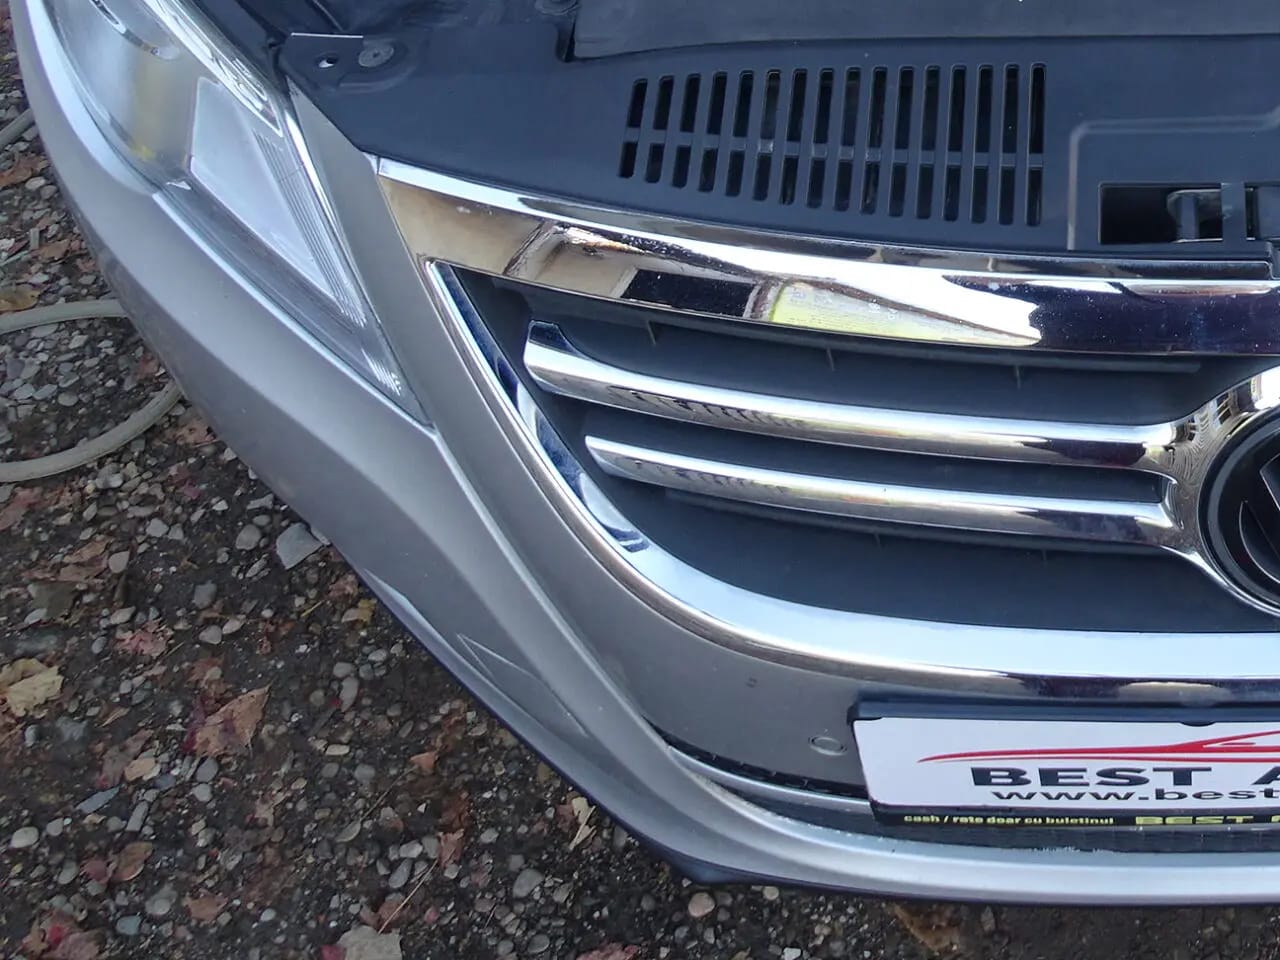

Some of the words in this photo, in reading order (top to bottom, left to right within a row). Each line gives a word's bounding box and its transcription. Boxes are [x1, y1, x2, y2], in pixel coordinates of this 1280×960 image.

[970, 767, 1213, 787] BEST
[903, 815, 940, 823] cash
[952, 816, 984, 825] rate
[985, 816, 1022, 825] doar
[1024, 817, 1043, 825] cu
[1045, 816, 1115, 825] buletinul
[1134, 815, 1254, 826] BEST
